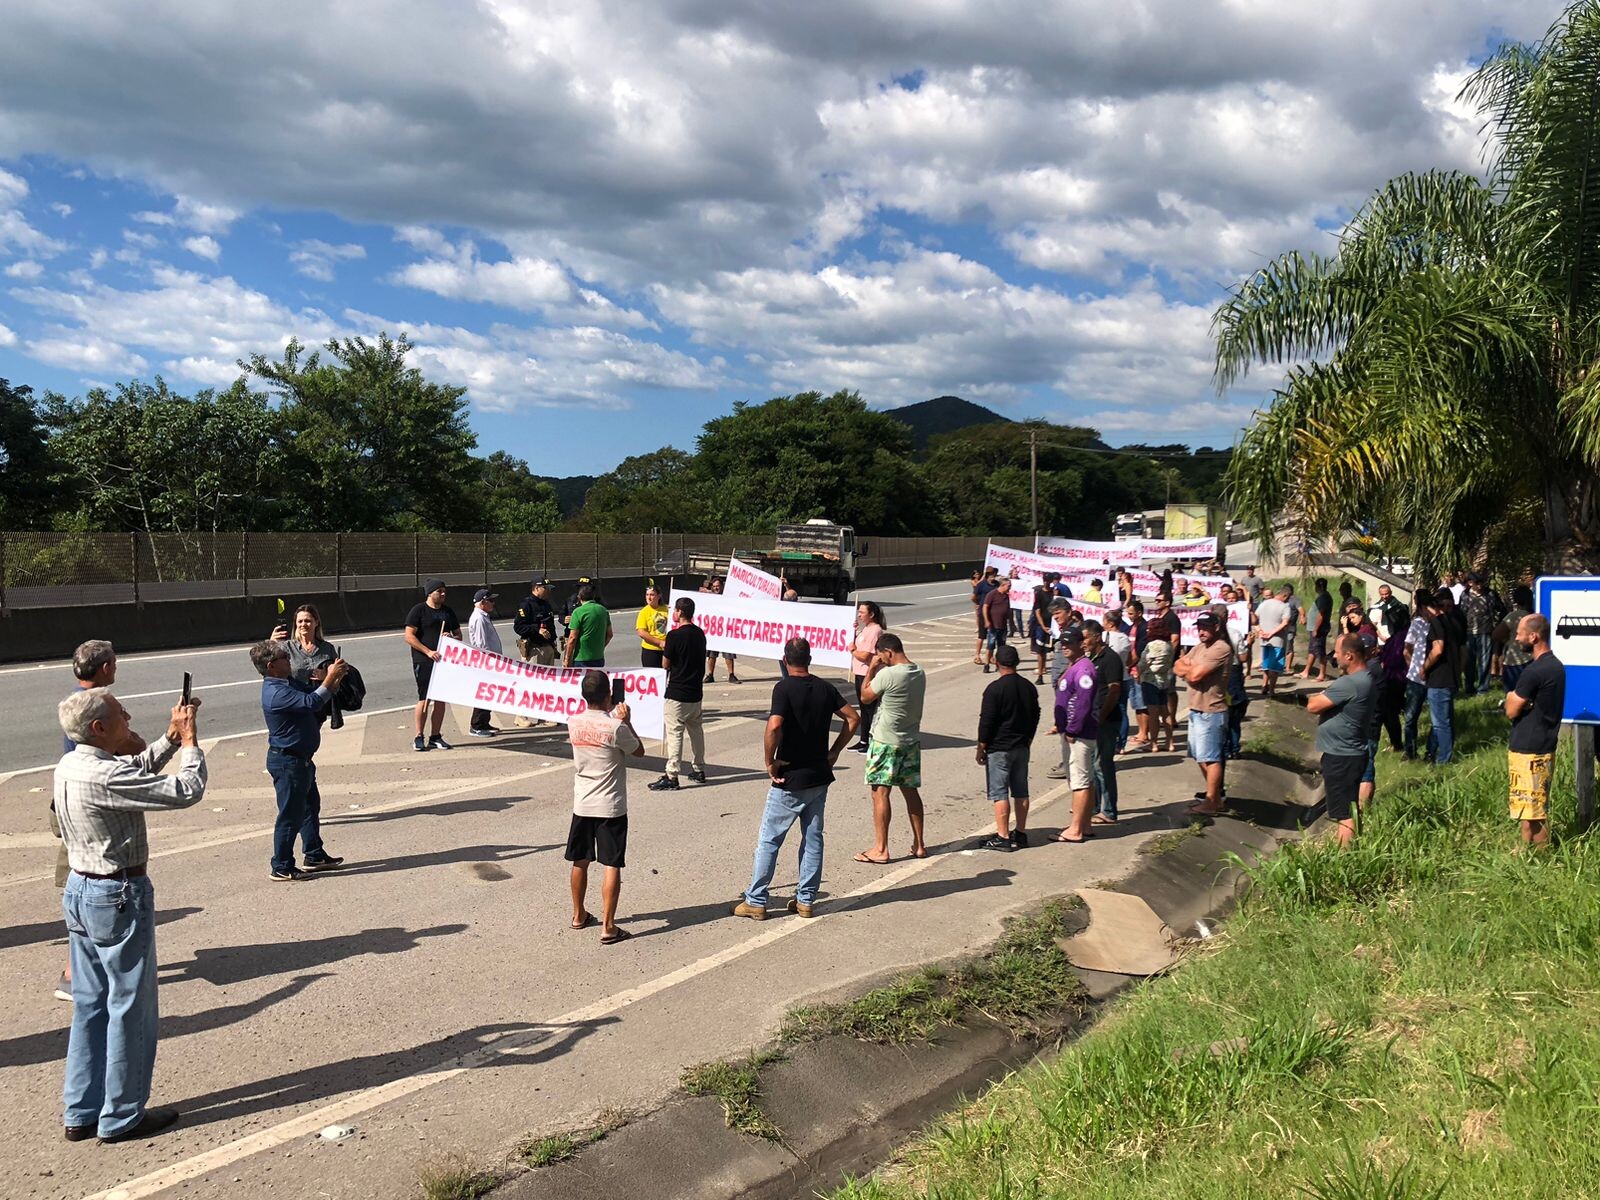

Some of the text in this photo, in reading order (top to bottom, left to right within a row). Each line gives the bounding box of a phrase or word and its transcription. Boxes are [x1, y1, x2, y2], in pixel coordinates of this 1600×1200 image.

[696, 613, 725, 637] 1988
[725, 617, 783, 645] HECTARES
[803, 625, 849, 652] TERRAS.
[443, 645, 557, 683] MARICULTURA
[559, 668, 582, 685] DE
[475, 681, 516, 706] ESTÁ
